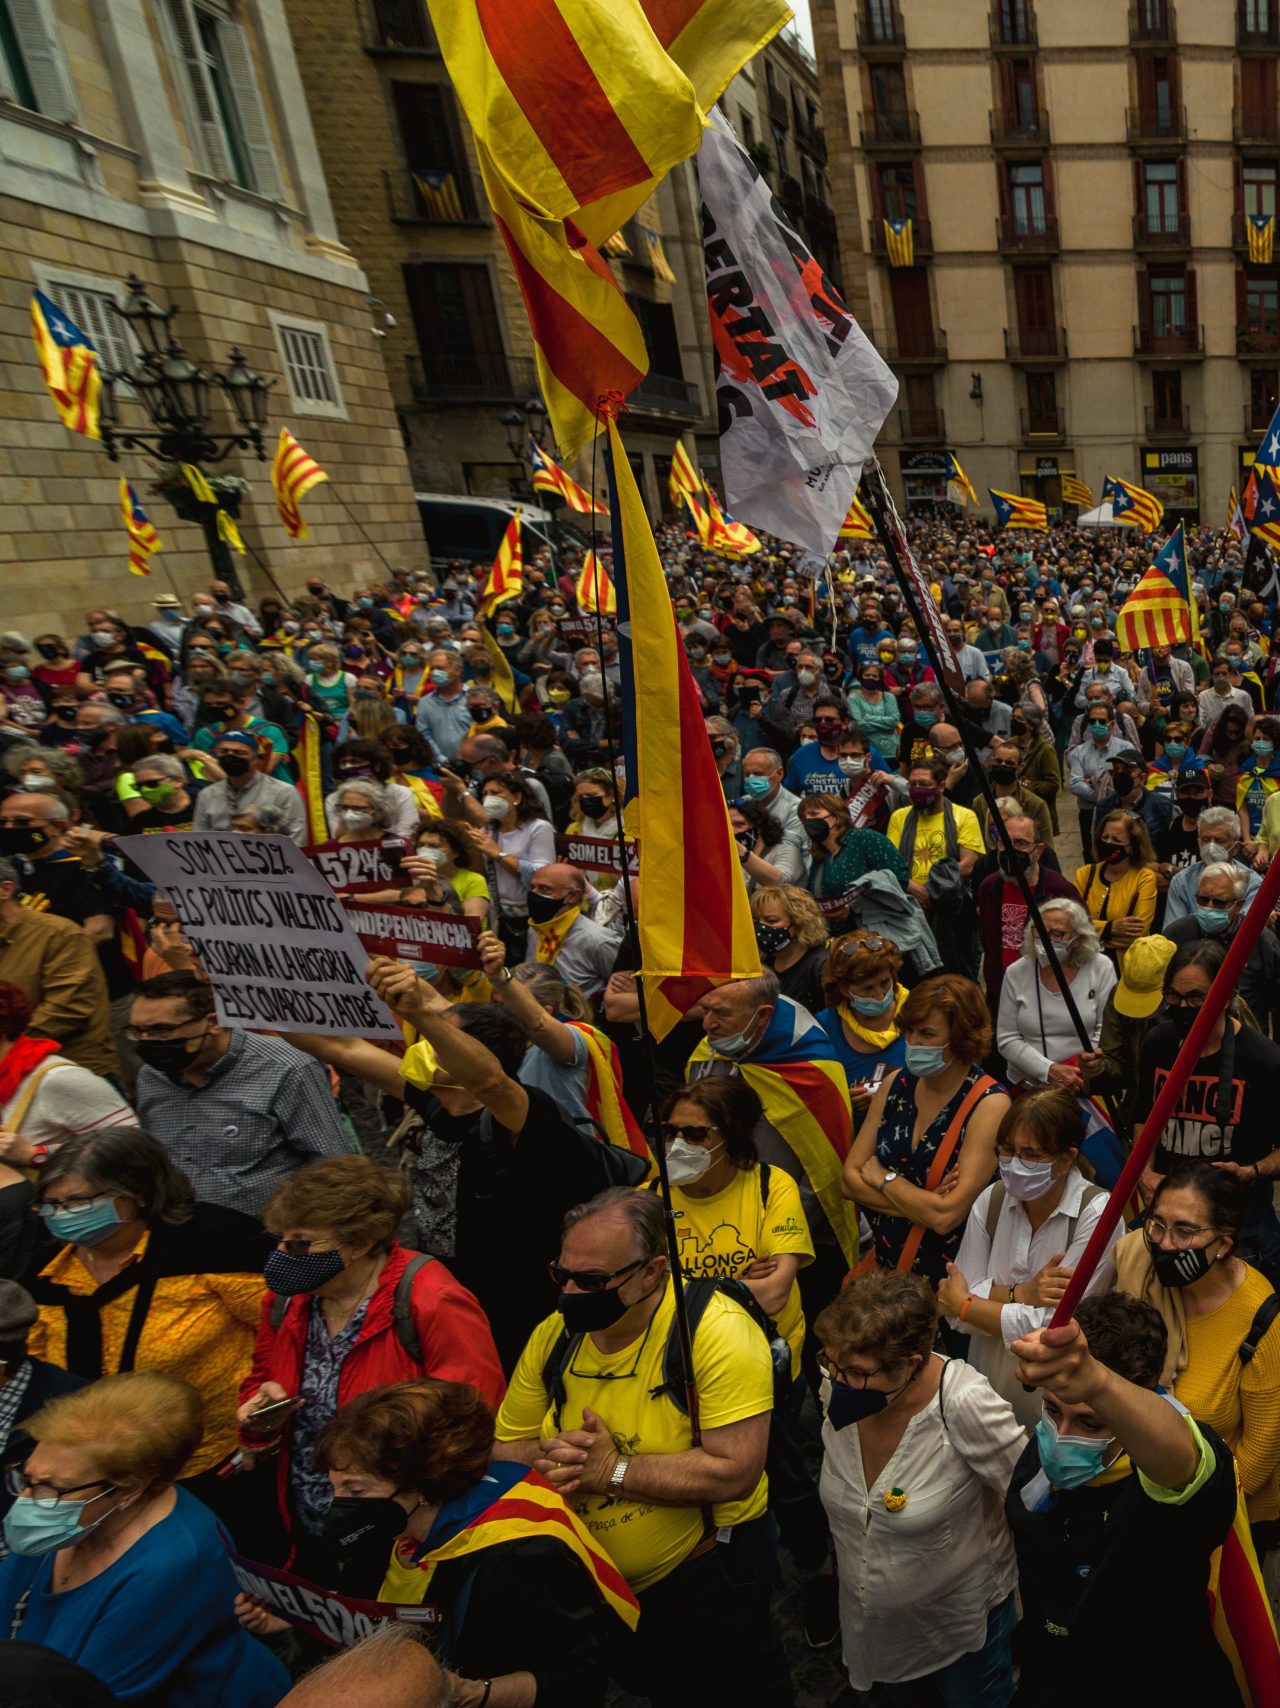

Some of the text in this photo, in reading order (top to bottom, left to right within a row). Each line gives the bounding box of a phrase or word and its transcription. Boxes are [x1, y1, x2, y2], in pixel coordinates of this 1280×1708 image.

[1161, 452, 1192, 468] pans
[166, 838, 294, 876] SOM EL 52%
[319, 846, 393, 889] 52%
[567, 842, 597, 864] SOM
[597, 847, 612, 866] EL
[164, 885, 344, 934] ELS POLÍTICS VALENTS
[588, 1518, 616, 1532] Plaça
[620, 1512, 633, 1524] de
